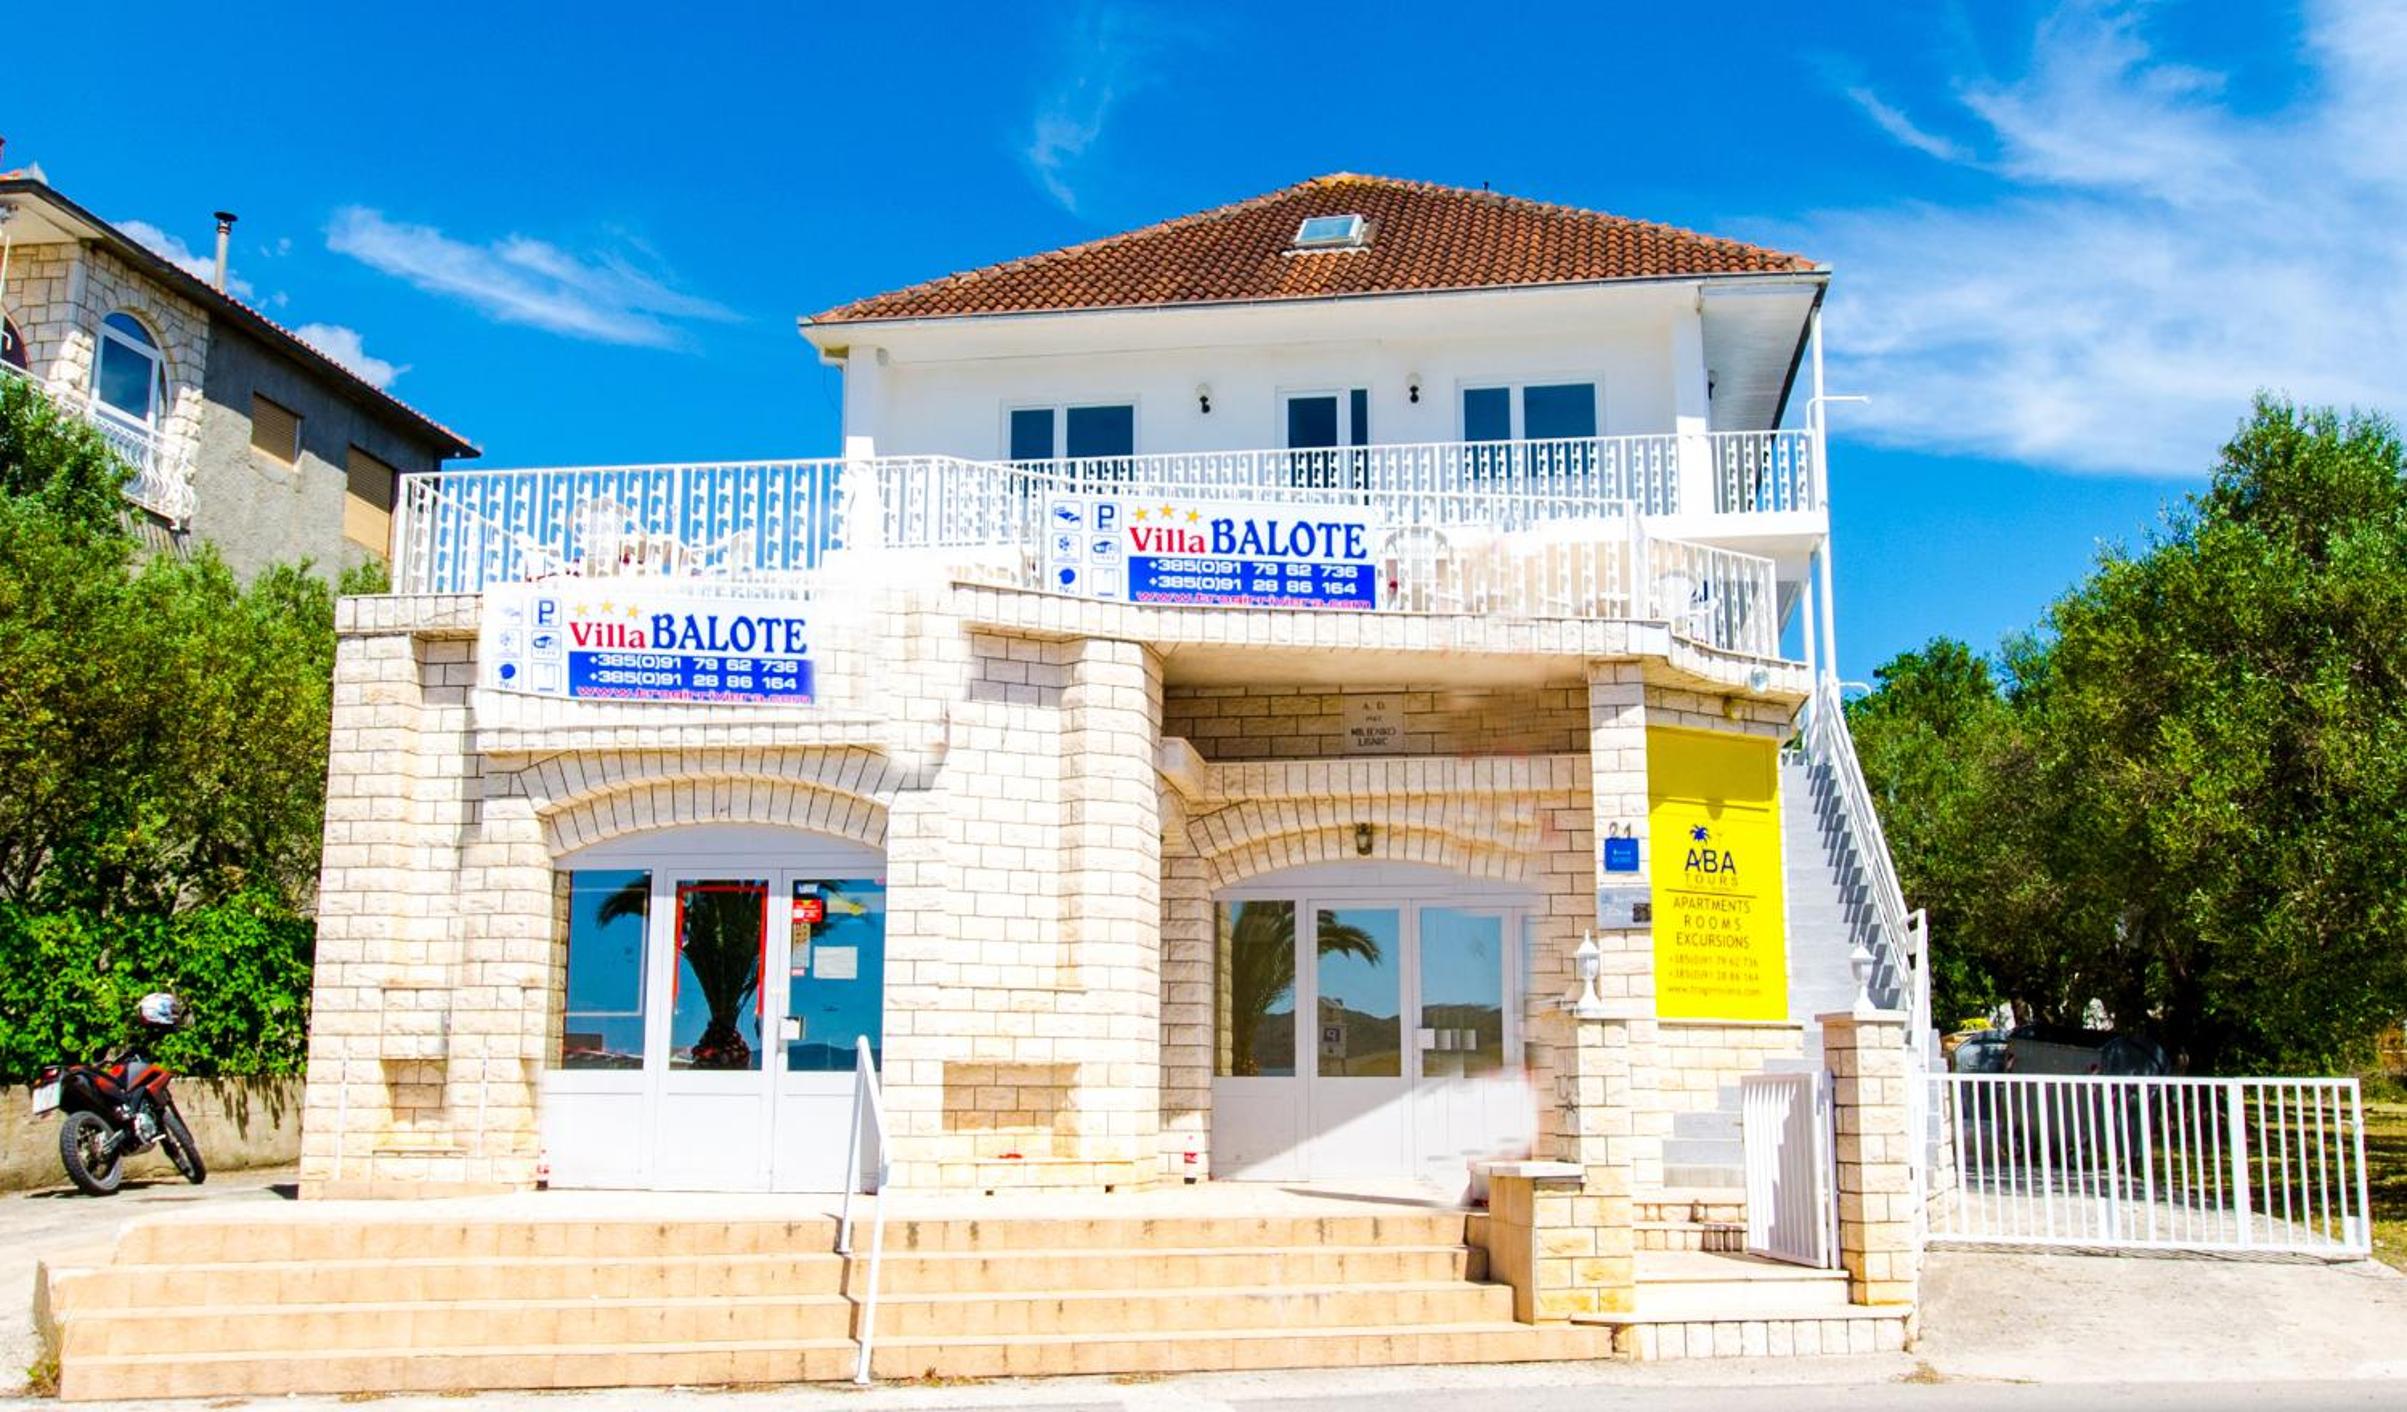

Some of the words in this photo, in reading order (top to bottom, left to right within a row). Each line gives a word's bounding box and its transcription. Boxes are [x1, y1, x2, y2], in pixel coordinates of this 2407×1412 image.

[1128, 526, 1206, 554] Villa
[1211, 518, 1367, 559] BALOTE
[1149, 558, 1242, 575] +385(0)91
[1253, 562, 1278, 576] 79
[1286, 563, 1312, 577] 62
[1320, 565, 1358, 579] 736
[1149, 574, 1242, 592] +385(0)91
[1253, 578, 1278, 592] 28
[1286, 580, 1313, 594] 86
[1322, 581, 1357, 595] 164
[568, 621, 646, 649] Villa
[651, 613, 807, 654] BALOTE
[589, 653, 682, 670] +385(0)91
[693, 656, 718, 671] 79
[726, 658, 752, 672] 62
[760, 659, 798, 673] 736
[589, 669, 682, 686] +385(0)91
[693, 673, 718, 687] 28
[726, 675, 753, 688] 86
[762, 676, 797, 690] 164
[1684, 848, 1736, 875] ABA
[1685, 873, 1738, 887] TOURS
[1673, 896, 1751, 914] APARTMENTS
[1684, 914, 1741, 931] ROOMS
[1676, 931, 1750, 950] EXCURSIONS
